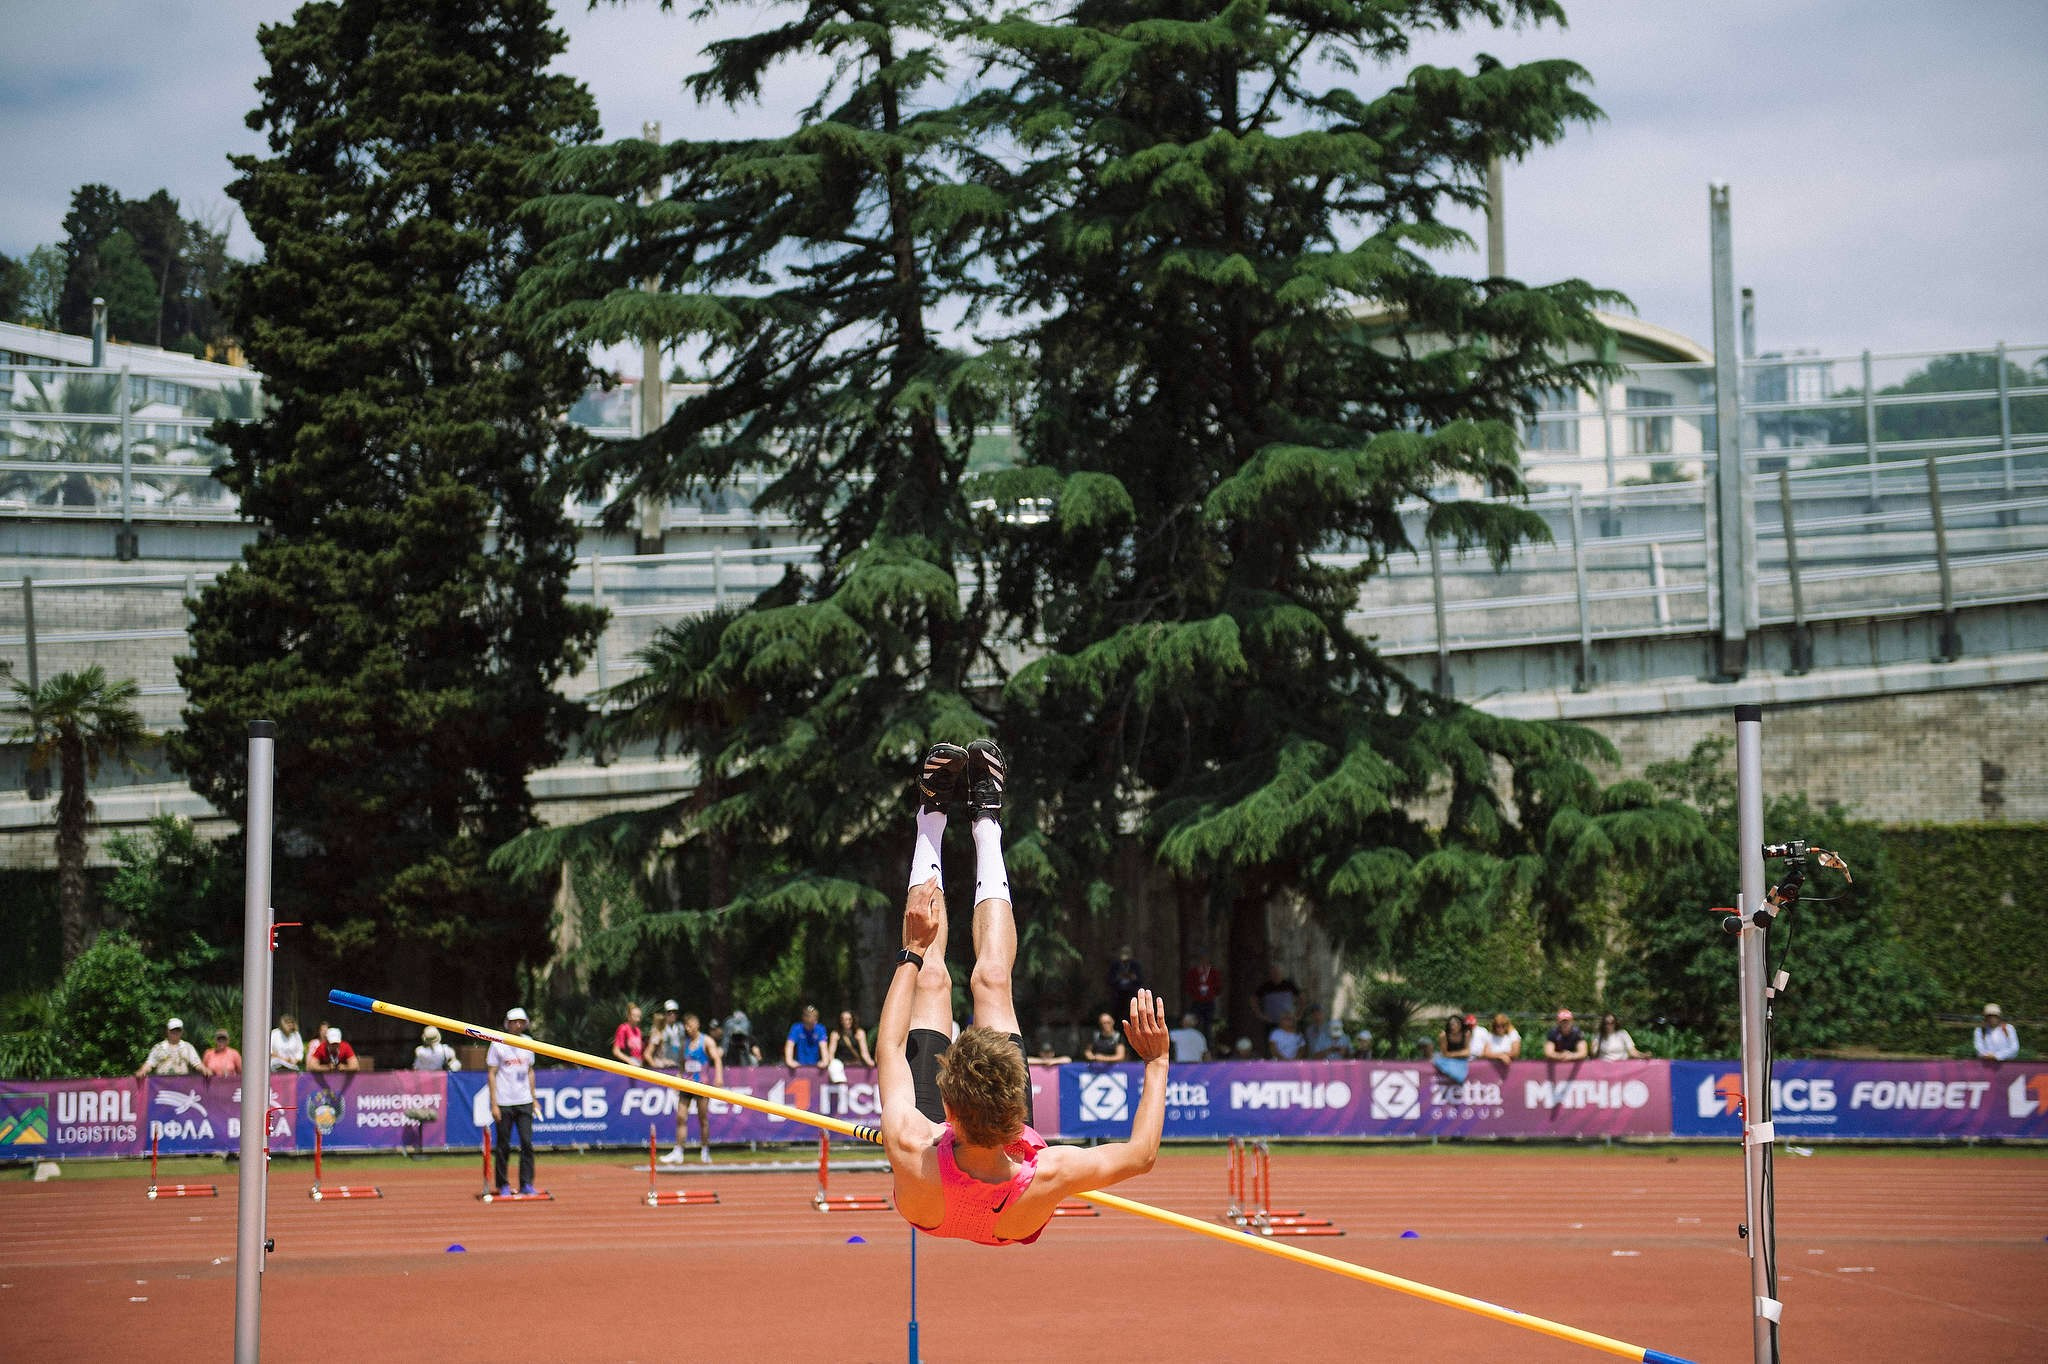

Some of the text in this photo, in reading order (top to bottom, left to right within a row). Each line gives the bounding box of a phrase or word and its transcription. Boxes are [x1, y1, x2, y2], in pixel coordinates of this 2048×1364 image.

[357, 1094, 442, 1110] МИНСПОРТ
[1850, 1081, 1991, 1110] FONBET
[57, 1090, 137, 1124] URAL
[57, 1124, 137, 1144] LOGISTICS
[149, 1118, 214, 1140] ВФЛА
[228, 1117, 291, 1138] ВА
